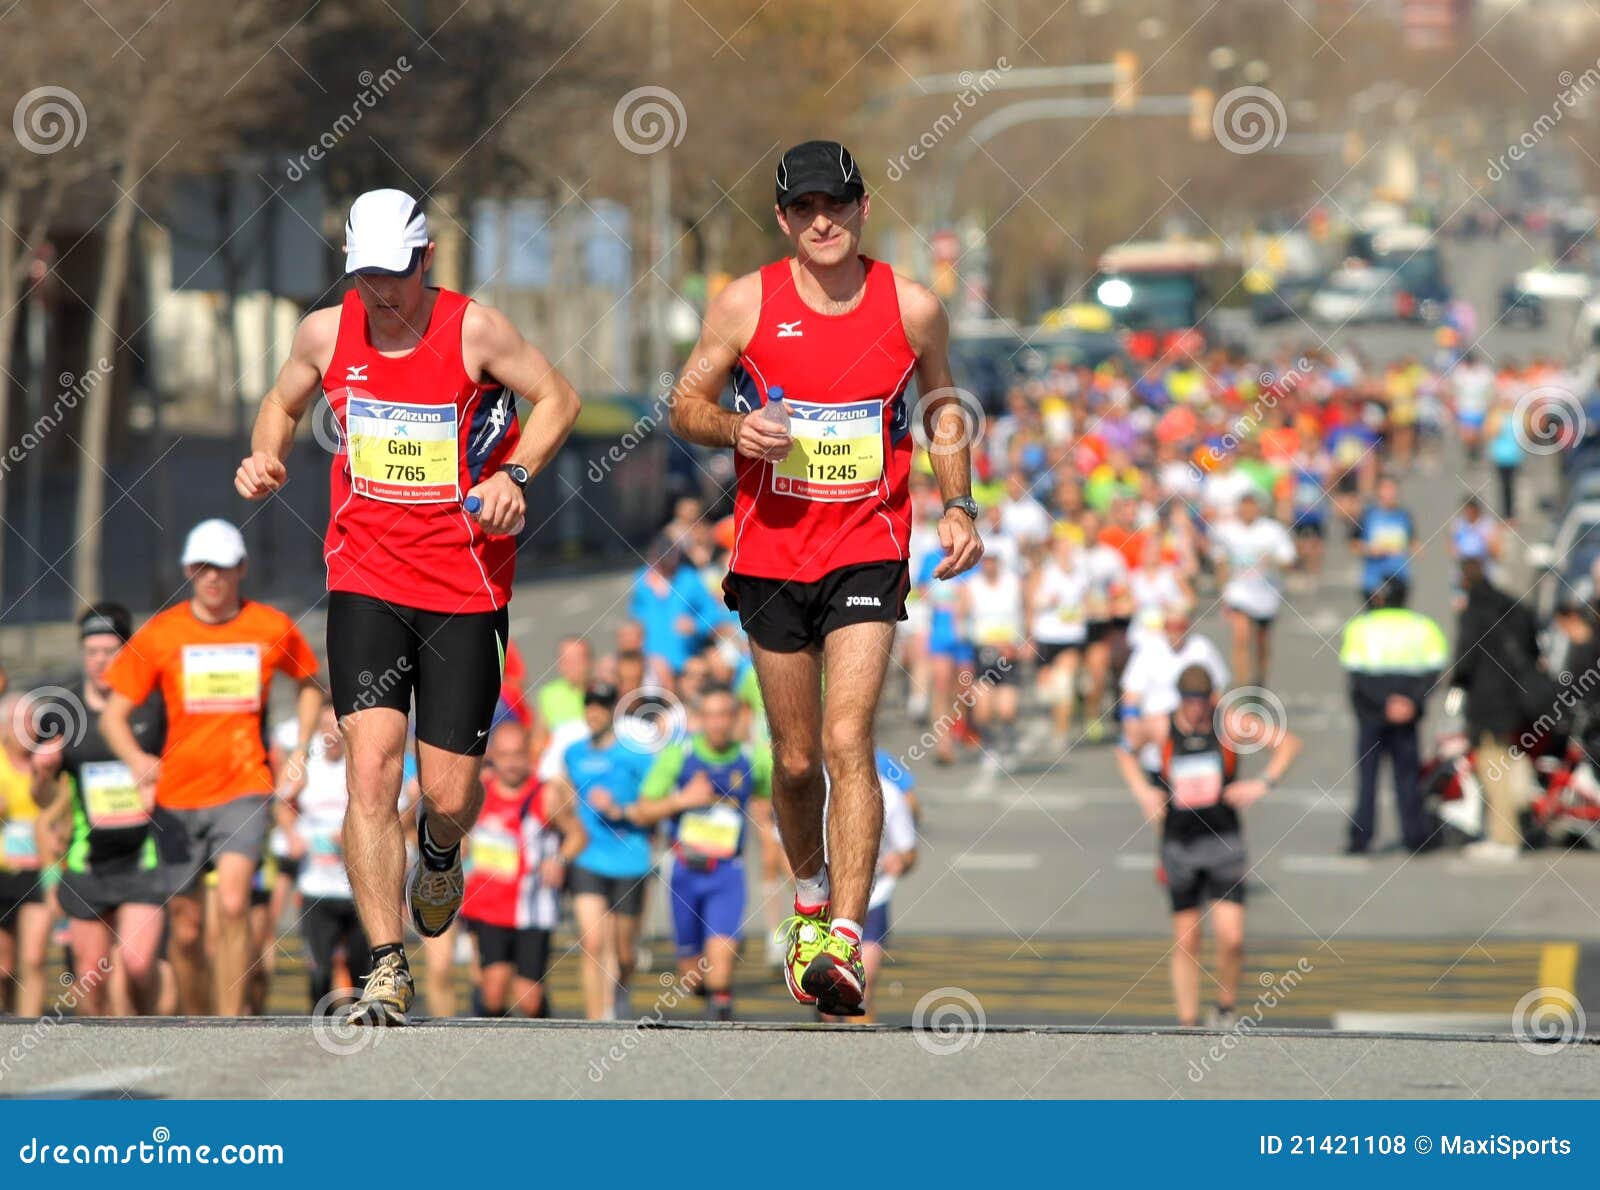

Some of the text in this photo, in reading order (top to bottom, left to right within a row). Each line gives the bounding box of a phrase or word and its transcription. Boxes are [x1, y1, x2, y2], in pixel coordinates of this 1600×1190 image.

[388, 440, 422, 456] Gabi
[813, 441, 851, 455] Joan
[385, 464, 426, 481] 7765
[807, 464, 857, 480] 11245
